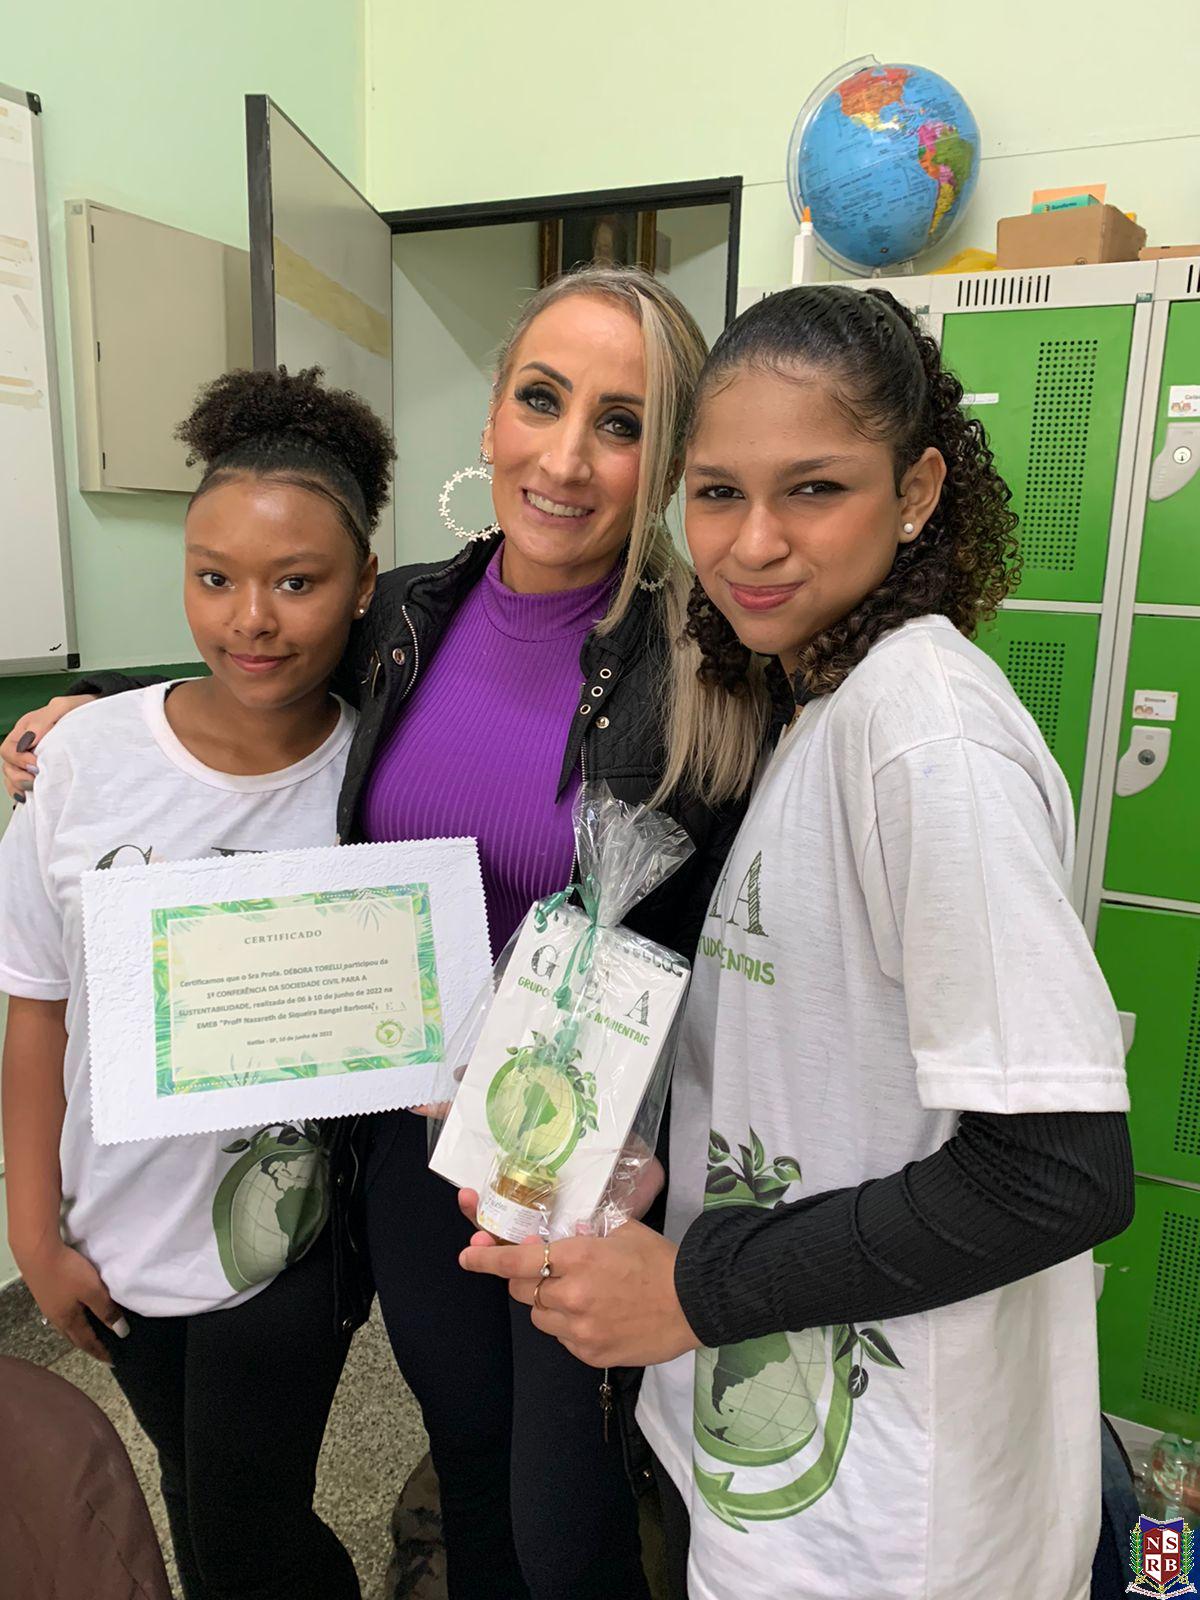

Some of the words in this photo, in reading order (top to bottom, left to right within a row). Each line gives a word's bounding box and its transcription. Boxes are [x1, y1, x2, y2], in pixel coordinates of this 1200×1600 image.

[726, 850, 769, 938] A
[244, 930, 322, 945] CERTIFICADO
[180, 977, 224, 988] Certificamos
[226, 975, 240, 983] que
[343, 960, 379, 971] participou
[216, 985, 267, 998] CONFERÊNCIA
[268, 984, 279, 992] DA
[280, 981, 320, 991] SOCIEDADE
[322, 978, 340, 986] CIVIL
[531, 944, 560, 981] G
[622, 990, 650, 1028] A
[179, 1003, 252, 1017] SUSTENTABILIDADE,
[253, 998, 285, 1008] realizada
[334, 991, 355, 1000] junho
[366, 987, 383, 995] 2022
[197, 1021, 218, 1030] EMEB
[243, 1014, 277, 1024] Nazareth
[288, 1009, 317, 1019] Siqueira
[318, 1006, 342, 1016] Rangel
